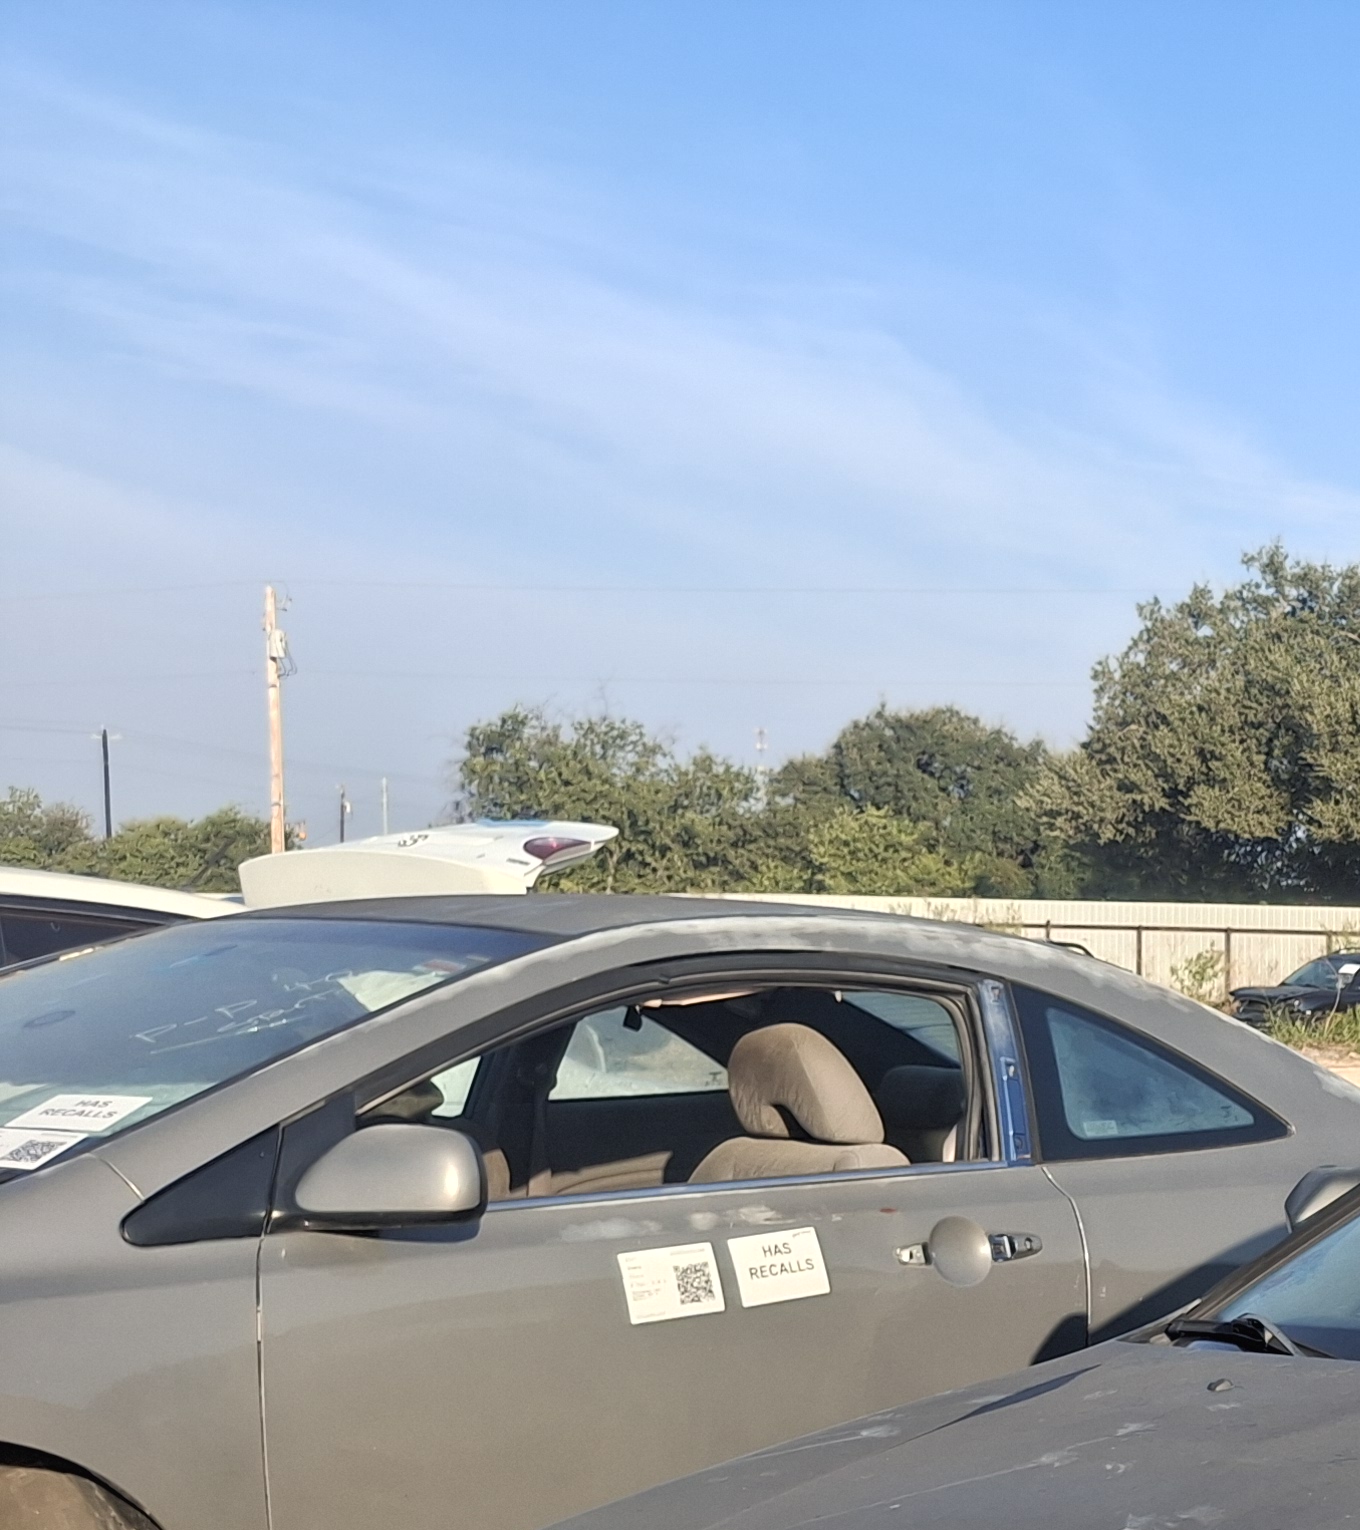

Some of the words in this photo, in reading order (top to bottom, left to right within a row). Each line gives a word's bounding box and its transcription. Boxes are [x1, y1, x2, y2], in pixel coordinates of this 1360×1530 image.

[75, 1100, 113, 1108] HAS
[39, 1108, 118, 1119] RECALLS
[762, 1242, 792, 1258] HAS
[748, 1258, 815, 1280] RECALLS
